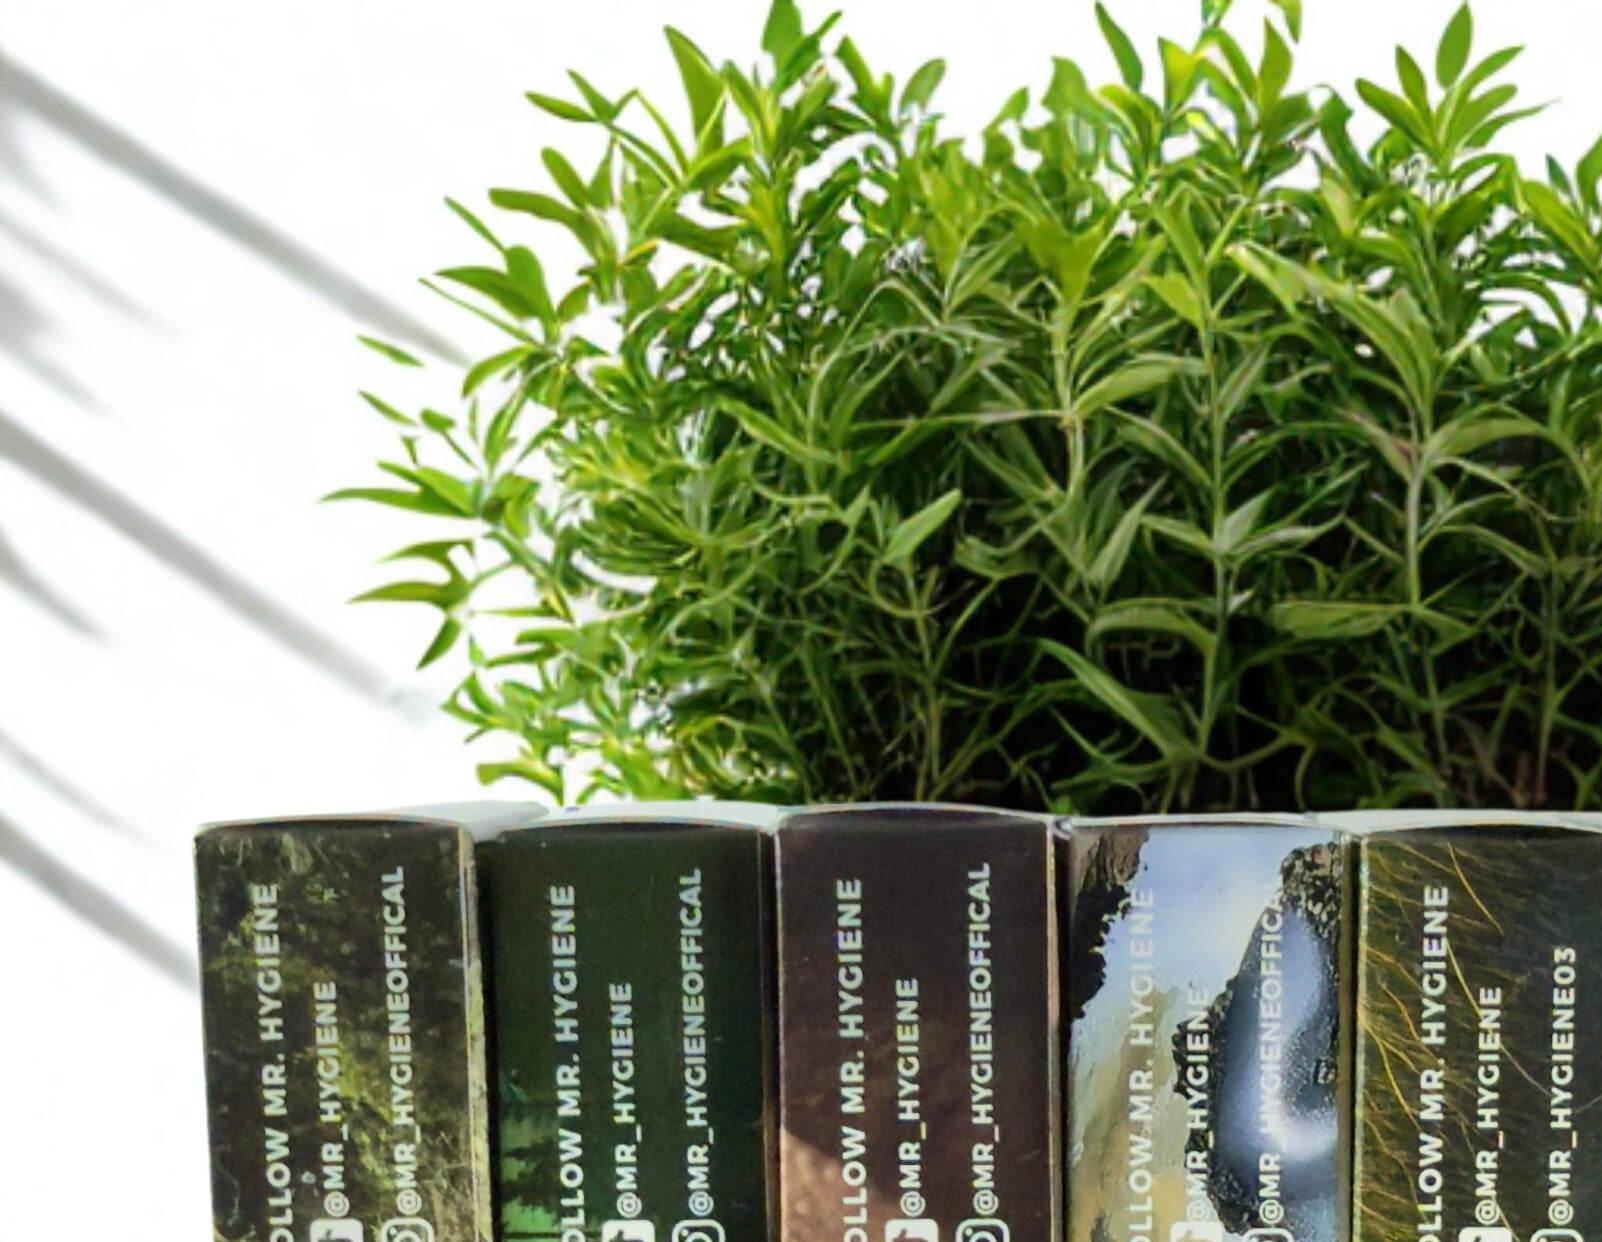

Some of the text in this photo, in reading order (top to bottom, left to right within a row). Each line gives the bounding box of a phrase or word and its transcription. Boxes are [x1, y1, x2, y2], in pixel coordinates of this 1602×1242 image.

[253, 883, 284, 1040] HYGIENE
[550, 885, 579, 1042] HYGIENE
[836, 878, 864, 1039] HYGIENE
[1128, 888, 1156, 1046] HYGIENE
[1419, 885, 1450, 1045] HYGIENE
[260, 1053, 288, 1115] MR.
[314, 982, 350, 1217] @MR_HYGIENE
[383, 867, 422, 1214] @MR_HYGIENEOFFICAL
[554, 1053, 582, 1115] MR.
[610, 982, 641, 1218] @MR_HYGIENE
[679, 868, 713, 1216] @MR_HYGIENEOFFICAL
[839, 1051, 866, 1114] MR.
[896, 978, 927, 1217] @MR_HYGIENE
[968, 863, 1000, 1215] @MR_HYGIENEOFFICAL
[1128, 1056, 1155, 1122] MR.
[1419, 1057, 1447, 1122] MR.
[1474, 987, 1503, 1226] @MR_HYGIENE
[1547, 947, 1576, 1225] @MR_HYGIENE03
